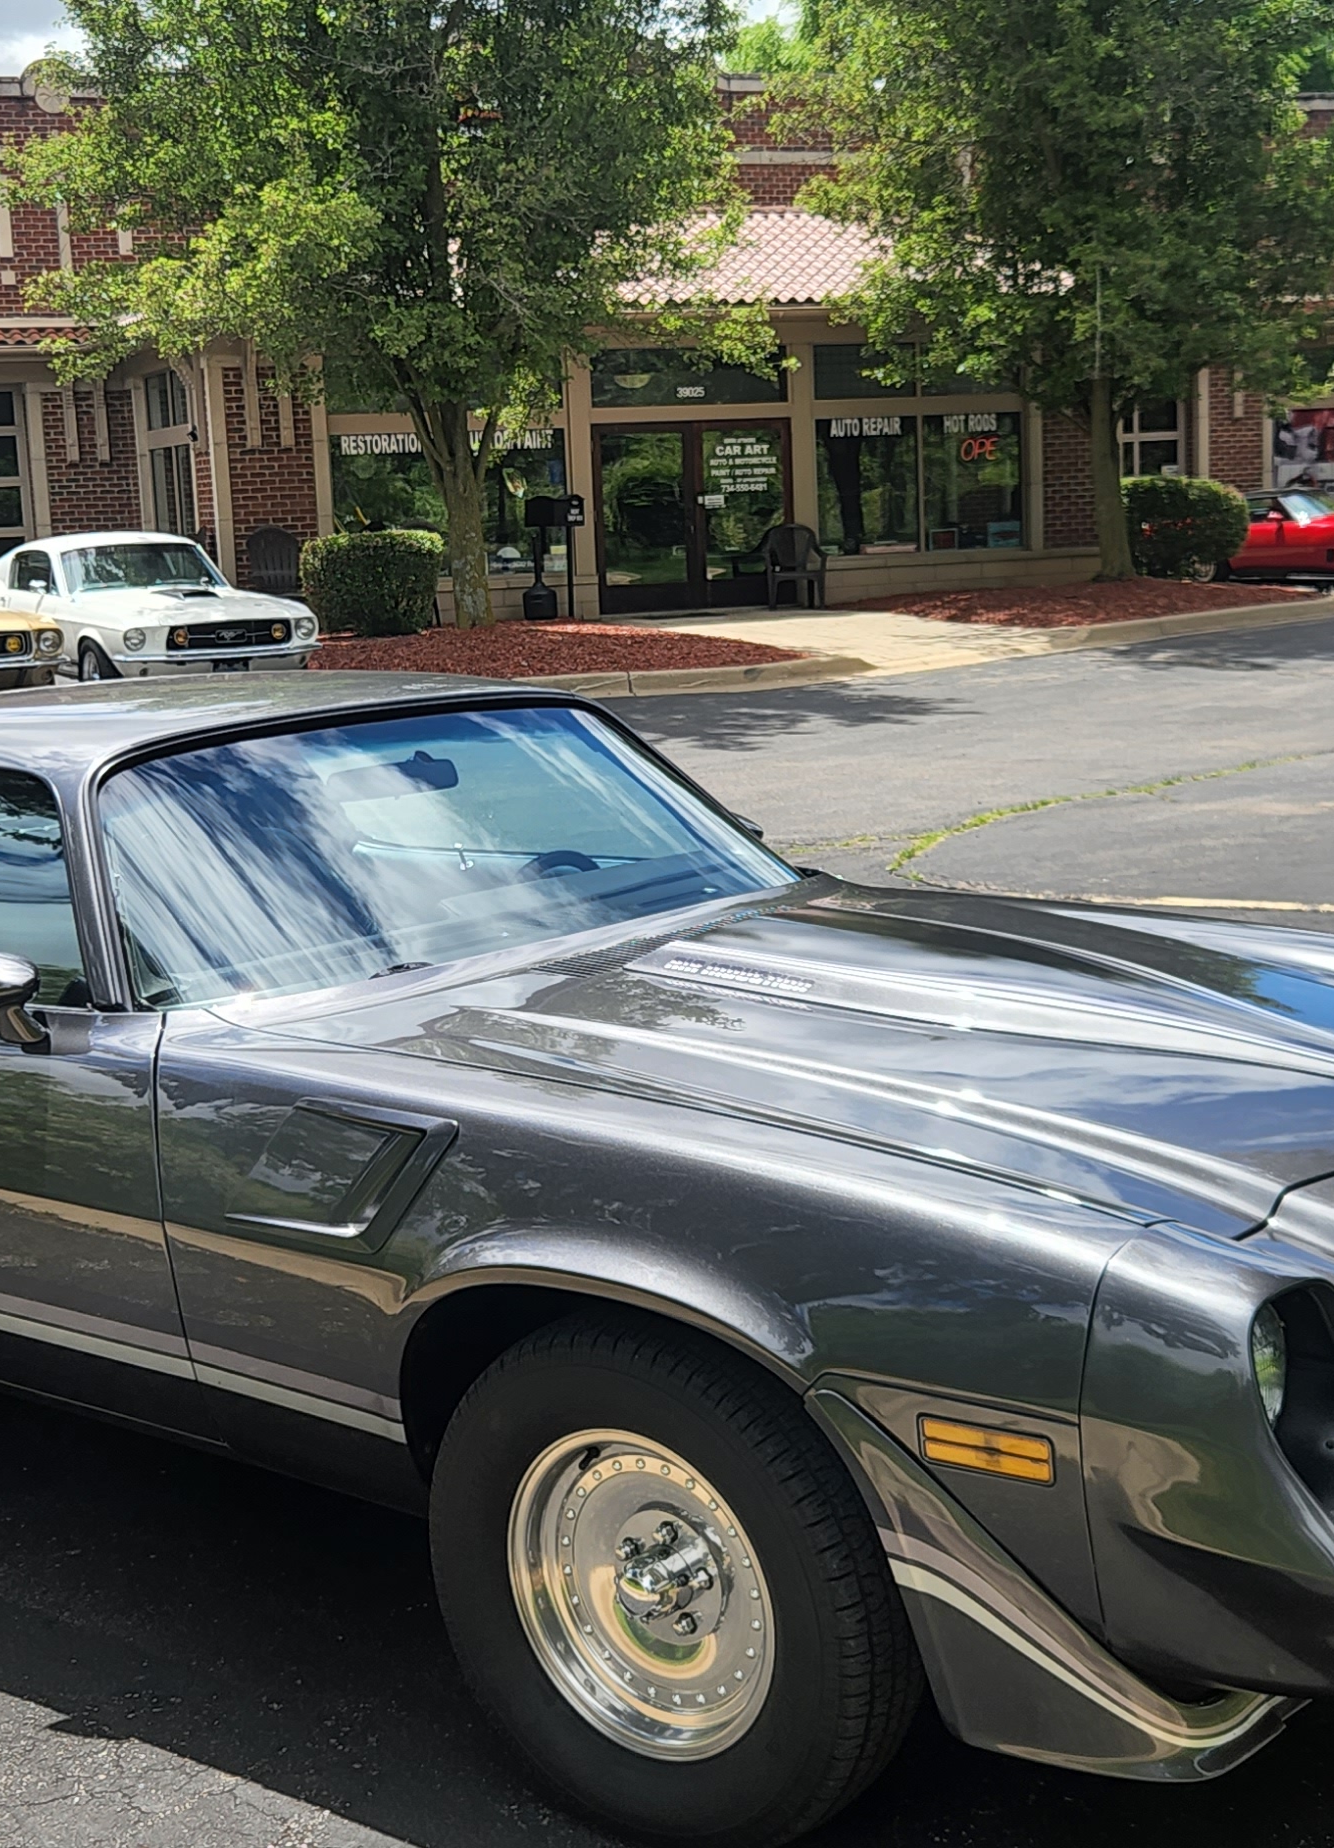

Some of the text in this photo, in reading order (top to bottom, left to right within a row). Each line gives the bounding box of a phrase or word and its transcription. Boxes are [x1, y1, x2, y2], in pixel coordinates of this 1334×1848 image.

[676, 386, 706, 398] 39025
[830, 417, 902, 437] AUTO REPAIR
[943, 414, 997, 433] HOT RODS
[715, 444, 770, 456] CAR ART
[961, 437, 1000, 461] OPE
